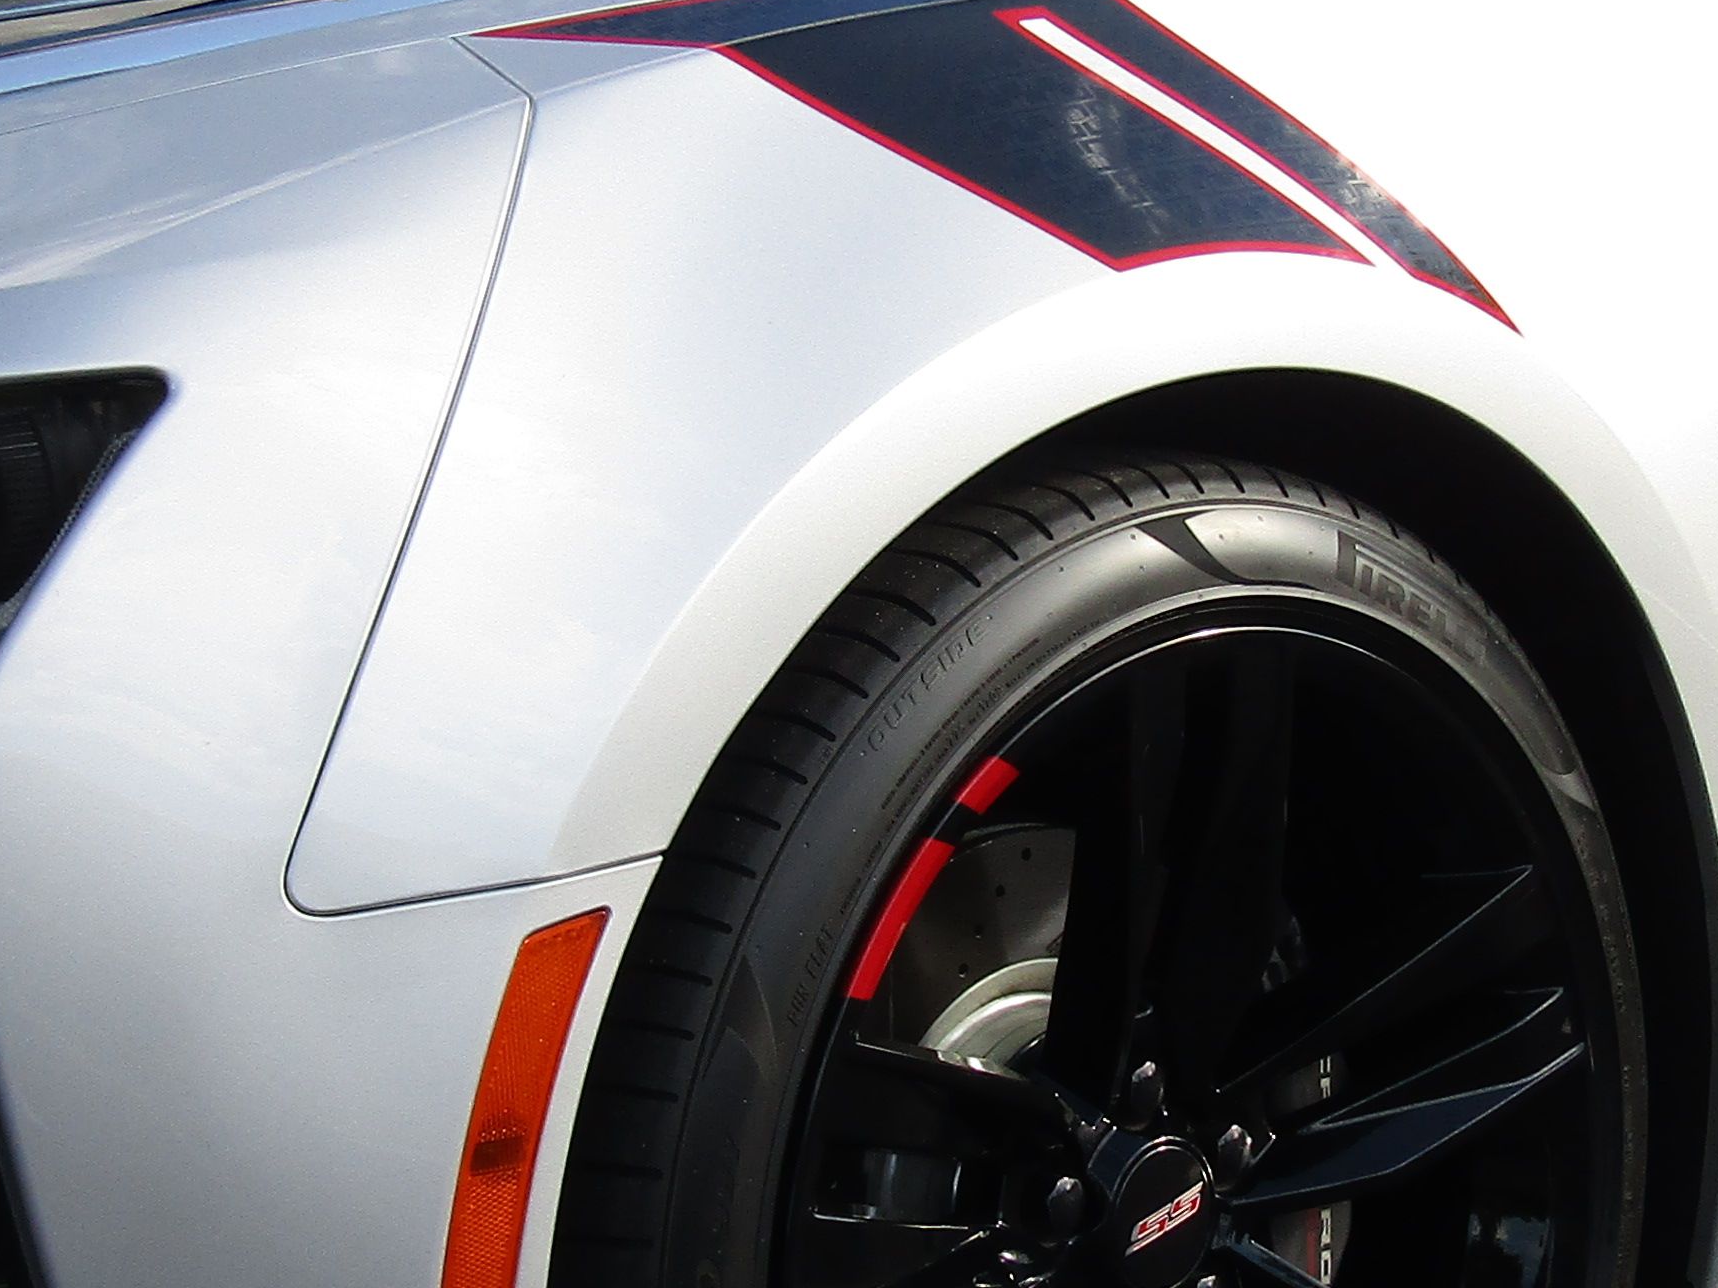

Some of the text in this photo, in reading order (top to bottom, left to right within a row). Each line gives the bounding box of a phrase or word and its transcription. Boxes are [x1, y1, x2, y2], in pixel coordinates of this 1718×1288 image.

[1337, 529, 1487, 666] PIRELL
[865, 620, 988, 754] OUTSIDE
[1124, 1180, 1204, 1257] SS
